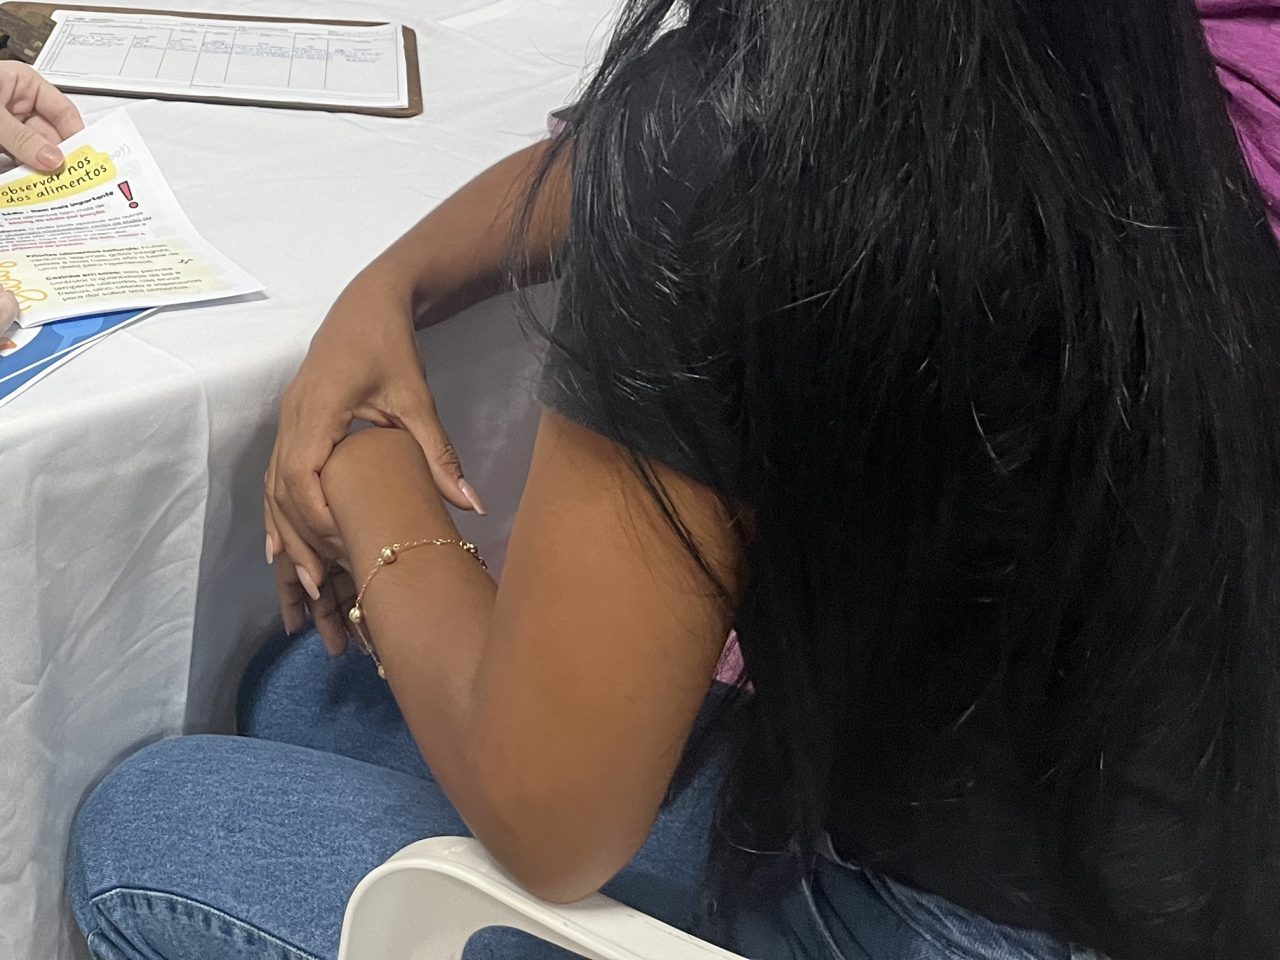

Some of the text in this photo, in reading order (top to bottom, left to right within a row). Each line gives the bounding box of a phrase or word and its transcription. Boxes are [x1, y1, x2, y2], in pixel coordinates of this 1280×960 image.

[1, 171, 62, 197] observar
[67, 155, 91, 175] nos
[6, 194, 31, 204] dos
[36, 165, 108, 198] alimentos
[69, 191, 114, 207] importante
